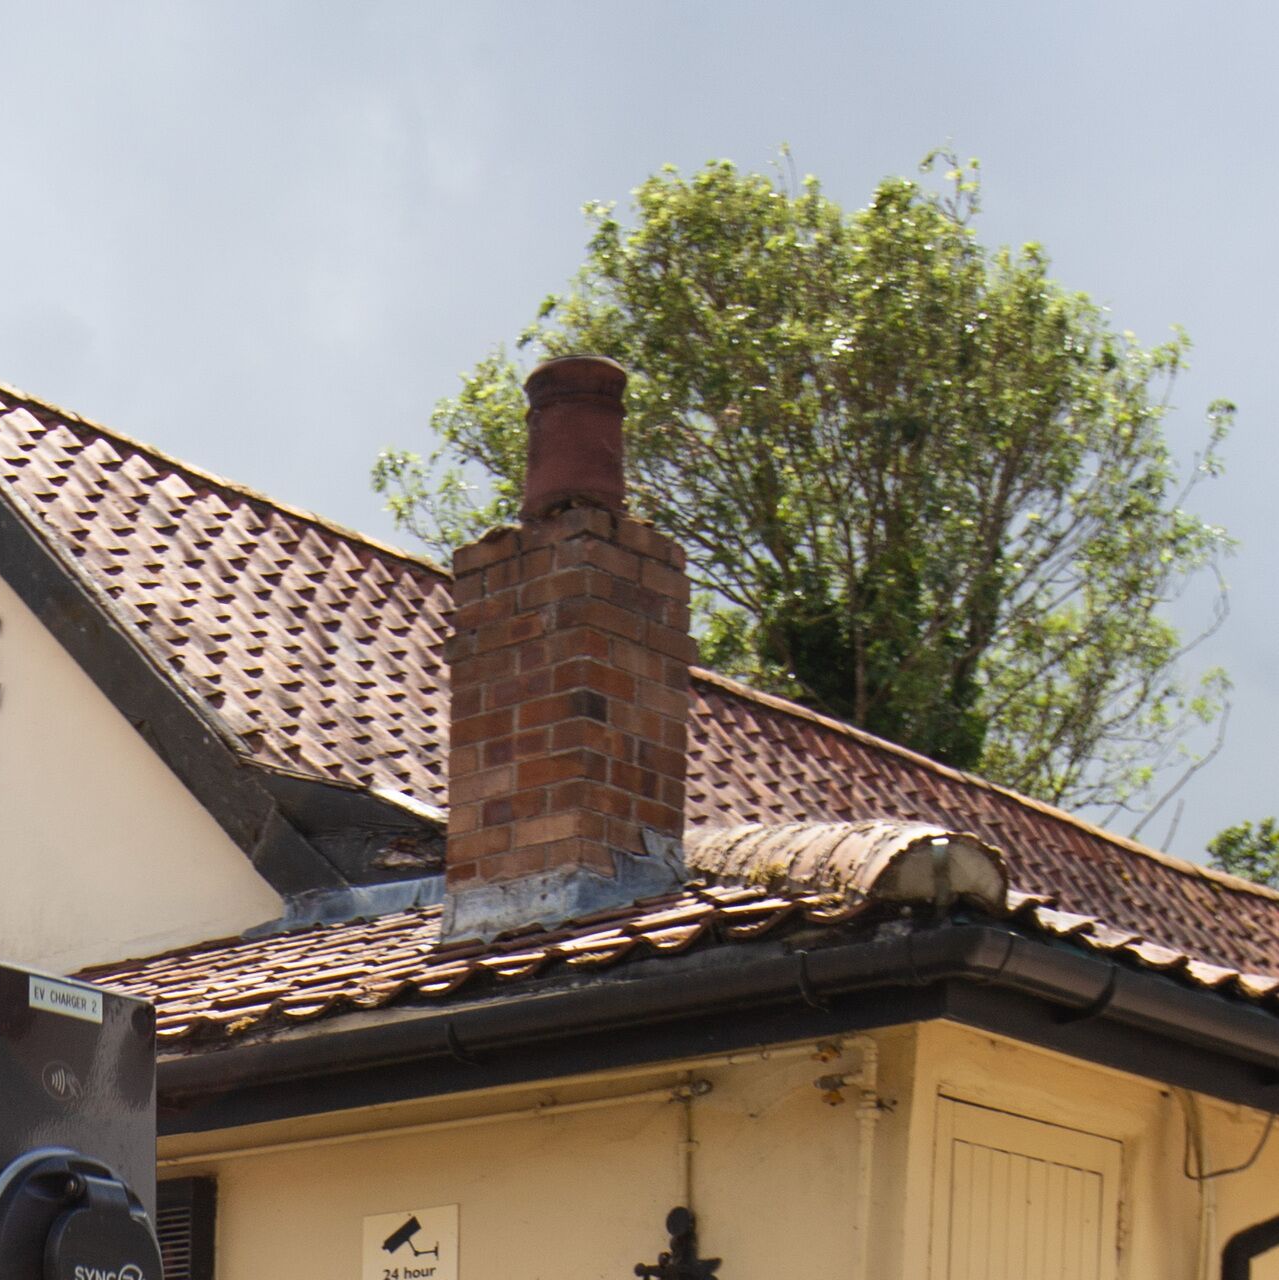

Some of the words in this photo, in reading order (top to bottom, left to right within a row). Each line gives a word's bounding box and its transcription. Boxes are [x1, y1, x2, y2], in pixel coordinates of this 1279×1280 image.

[34, 985, 45, 1000] EV
[50, 990, 87, 1011] CHARGER
[91, 1000, 97, 1013] 2
[383, 1269, 399, 1280] 24
[404, 1266, 436, 1280] hour
